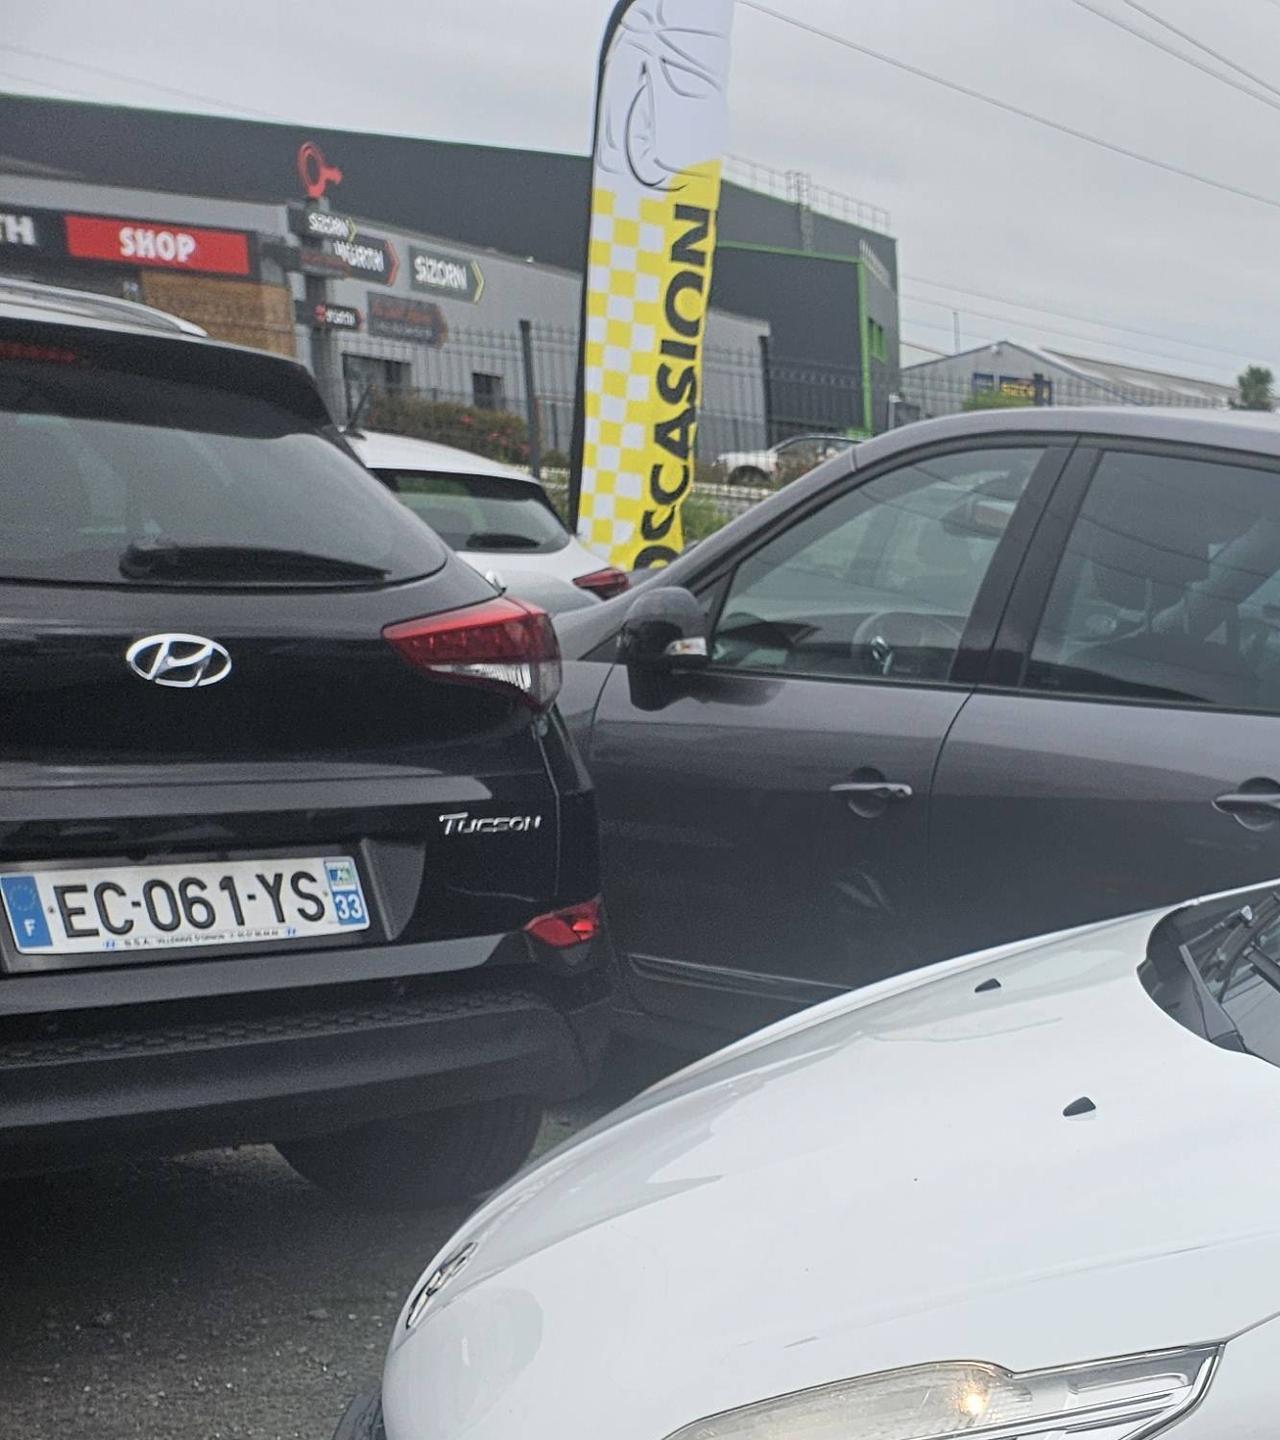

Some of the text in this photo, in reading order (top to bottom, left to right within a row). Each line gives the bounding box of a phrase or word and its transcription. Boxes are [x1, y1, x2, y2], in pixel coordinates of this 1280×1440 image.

[119, 226, 196, 263] SHOP
[53, 871, 326, 939] EC-061-YS
[335, 894, 362, 920] 33
[24, 918, 37, 938] F
